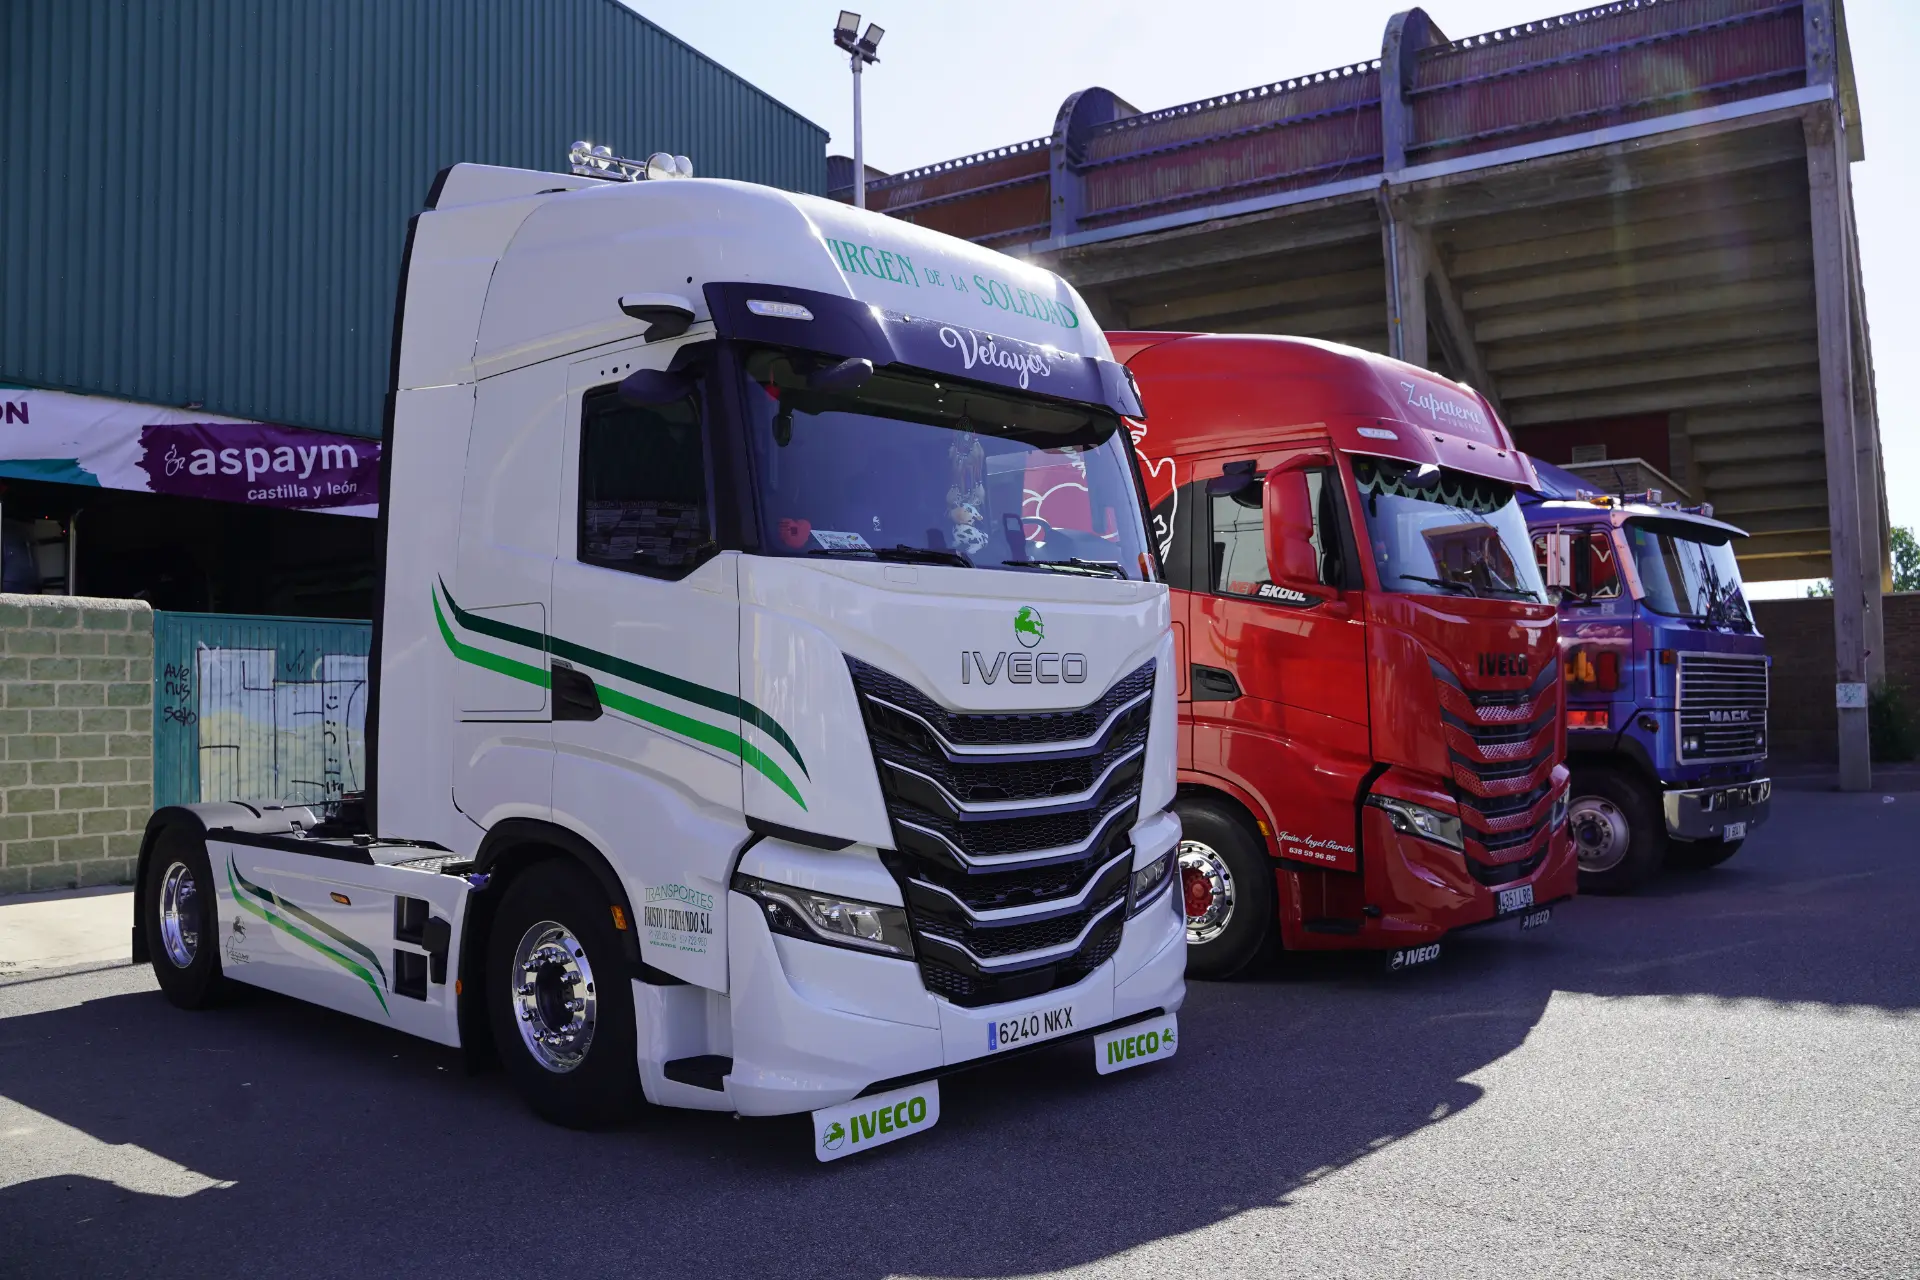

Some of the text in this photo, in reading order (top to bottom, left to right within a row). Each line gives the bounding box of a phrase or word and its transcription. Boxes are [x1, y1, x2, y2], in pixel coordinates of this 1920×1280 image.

[924, 268, 944, 286] DE
[951, 274, 969, 293] LA
[973, 275, 1079, 329] SOLEDAD
[939, 327, 1050, 389] Velayos
[1400, 381, 1483, 424] Zapatera
[188, 444, 359, 482] aspaym
[247, 481, 357, 500] castilla y león
[1228, 581, 1307, 602] NEW SKOOL
[961, 651, 1087, 685] IVECO
[1478, 652, 1528, 676] IVECO
[1709, 711, 1750, 722] MACK
[645, 884, 714, 909] TRANSPORTES
[700, 912, 713, 935] S.L.
[1528, 910, 1550, 928] IVECO
[1404, 943, 1440, 966] IVECO
[999, 1007, 1074, 1045] 6240 NKX
[1107, 1031, 1159, 1064] IVECO
[850, 1096, 927, 1143] IVECO
